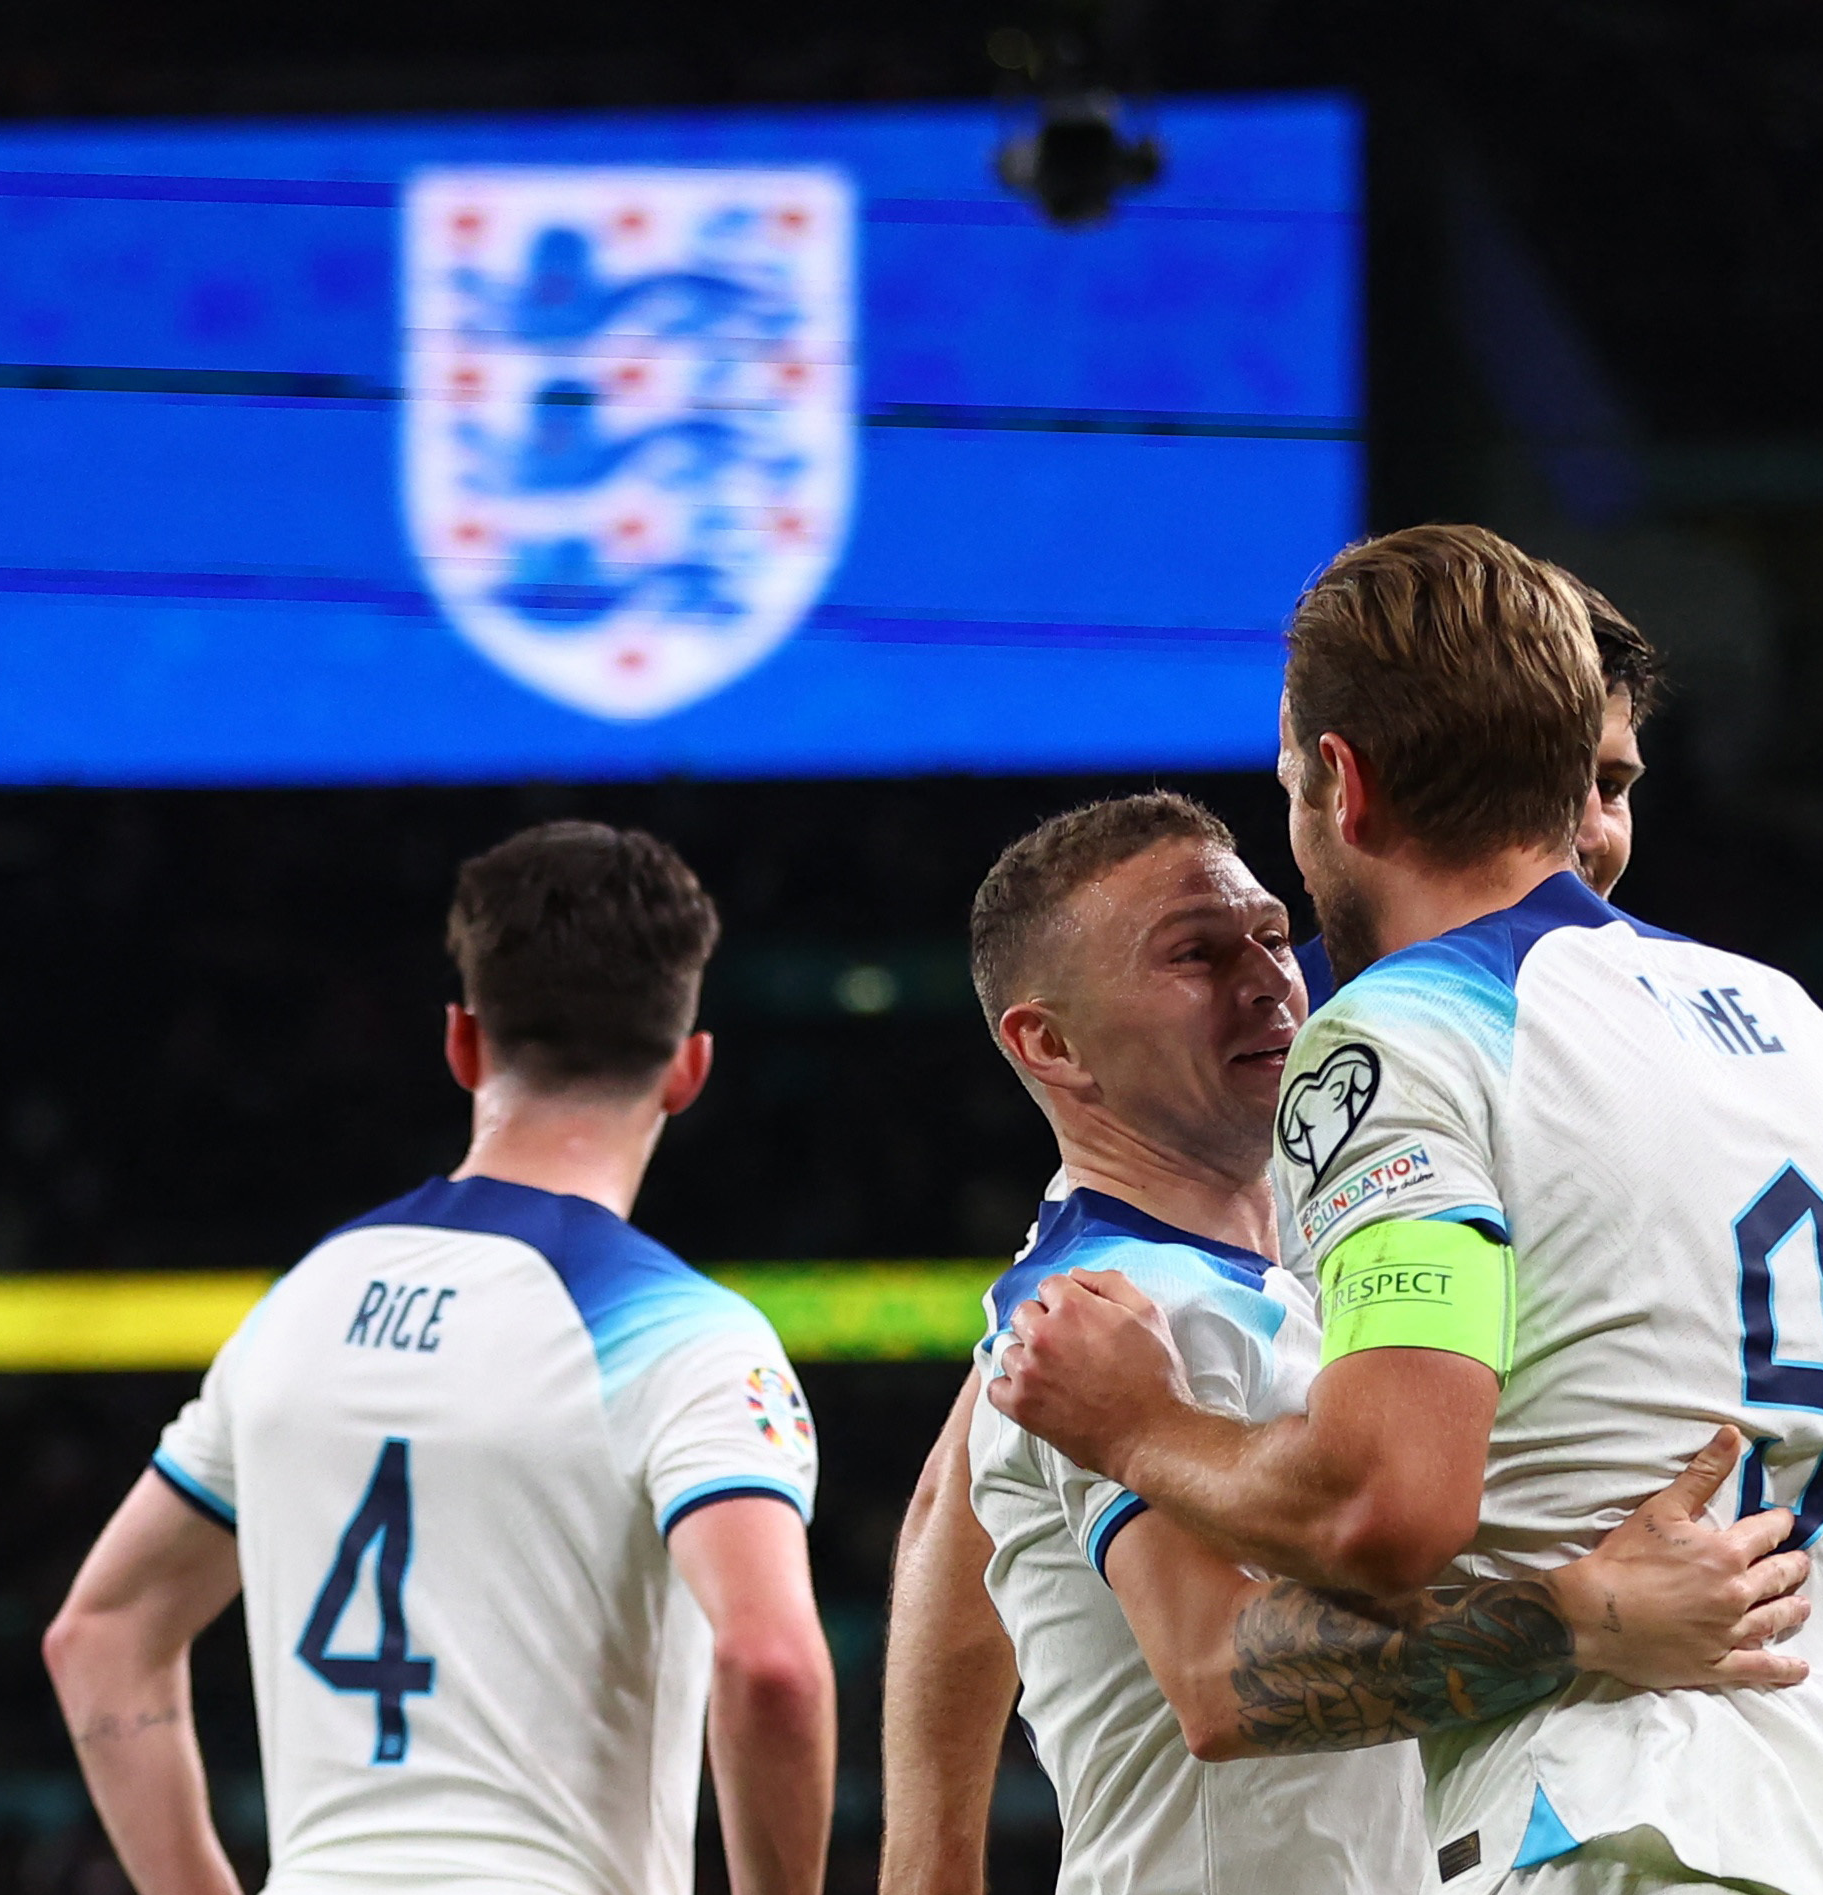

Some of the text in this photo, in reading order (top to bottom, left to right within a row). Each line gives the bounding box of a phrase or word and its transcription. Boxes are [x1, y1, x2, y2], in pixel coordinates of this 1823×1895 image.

[1635, 975, 1787, 1056] NE
[1386, 1172, 1434, 1199] for children
[345, 1280, 458, 1354] RICE
[1333, 1272, 1452, 1311] RESPECT
[294, 1436, 436, 1766] 4
